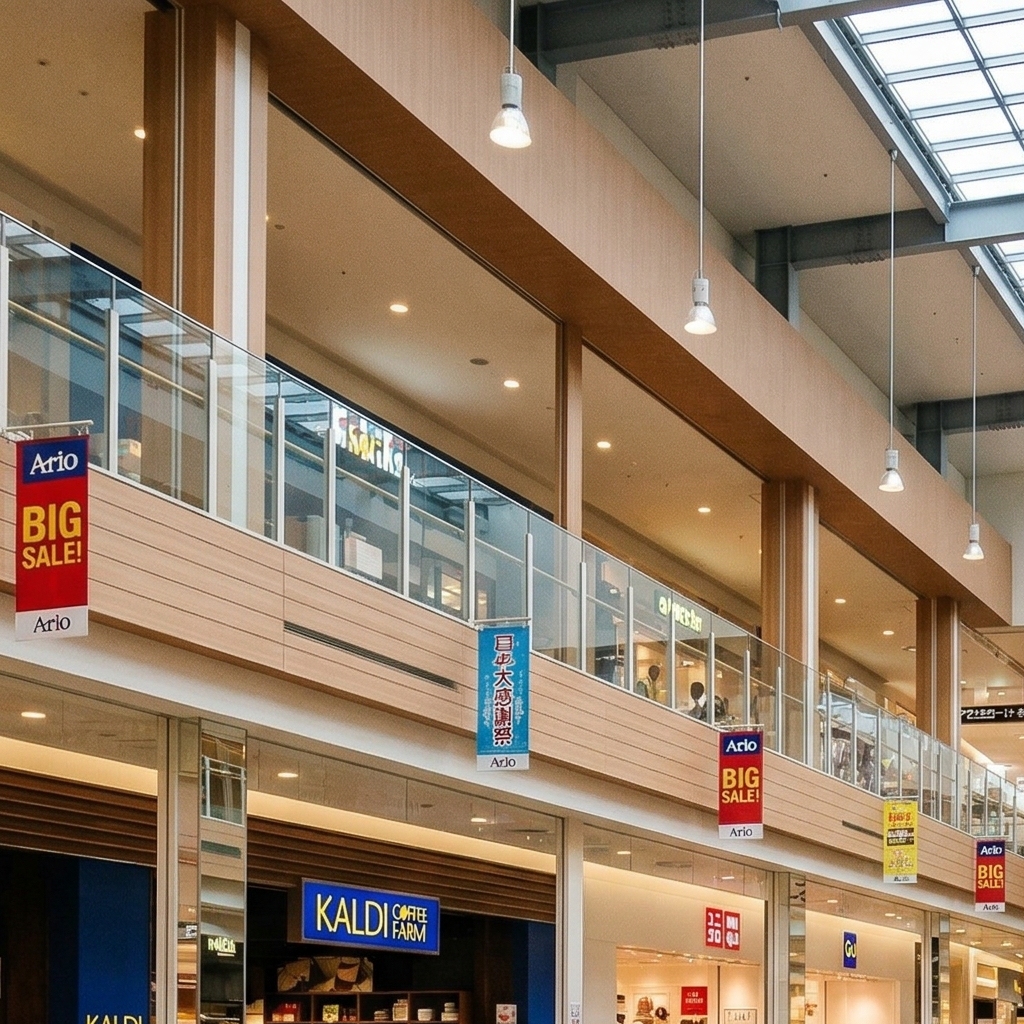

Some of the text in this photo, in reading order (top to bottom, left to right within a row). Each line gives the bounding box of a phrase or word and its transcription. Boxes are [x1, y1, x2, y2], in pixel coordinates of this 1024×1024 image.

[29, 450, 79, 476] Ario
[22, 500, 82, 544] BIG
[21, 541, 82, 570] SALE!
[722, 766, 760, 789] BIG
[721, 788, 760, 804] SALE!
[729, 826, 753, 837] Ario
[977, 864, 1004, 880] BIG
[316, 893, 388, 938] KALDI
[392, 920, 426, 943] FARM
